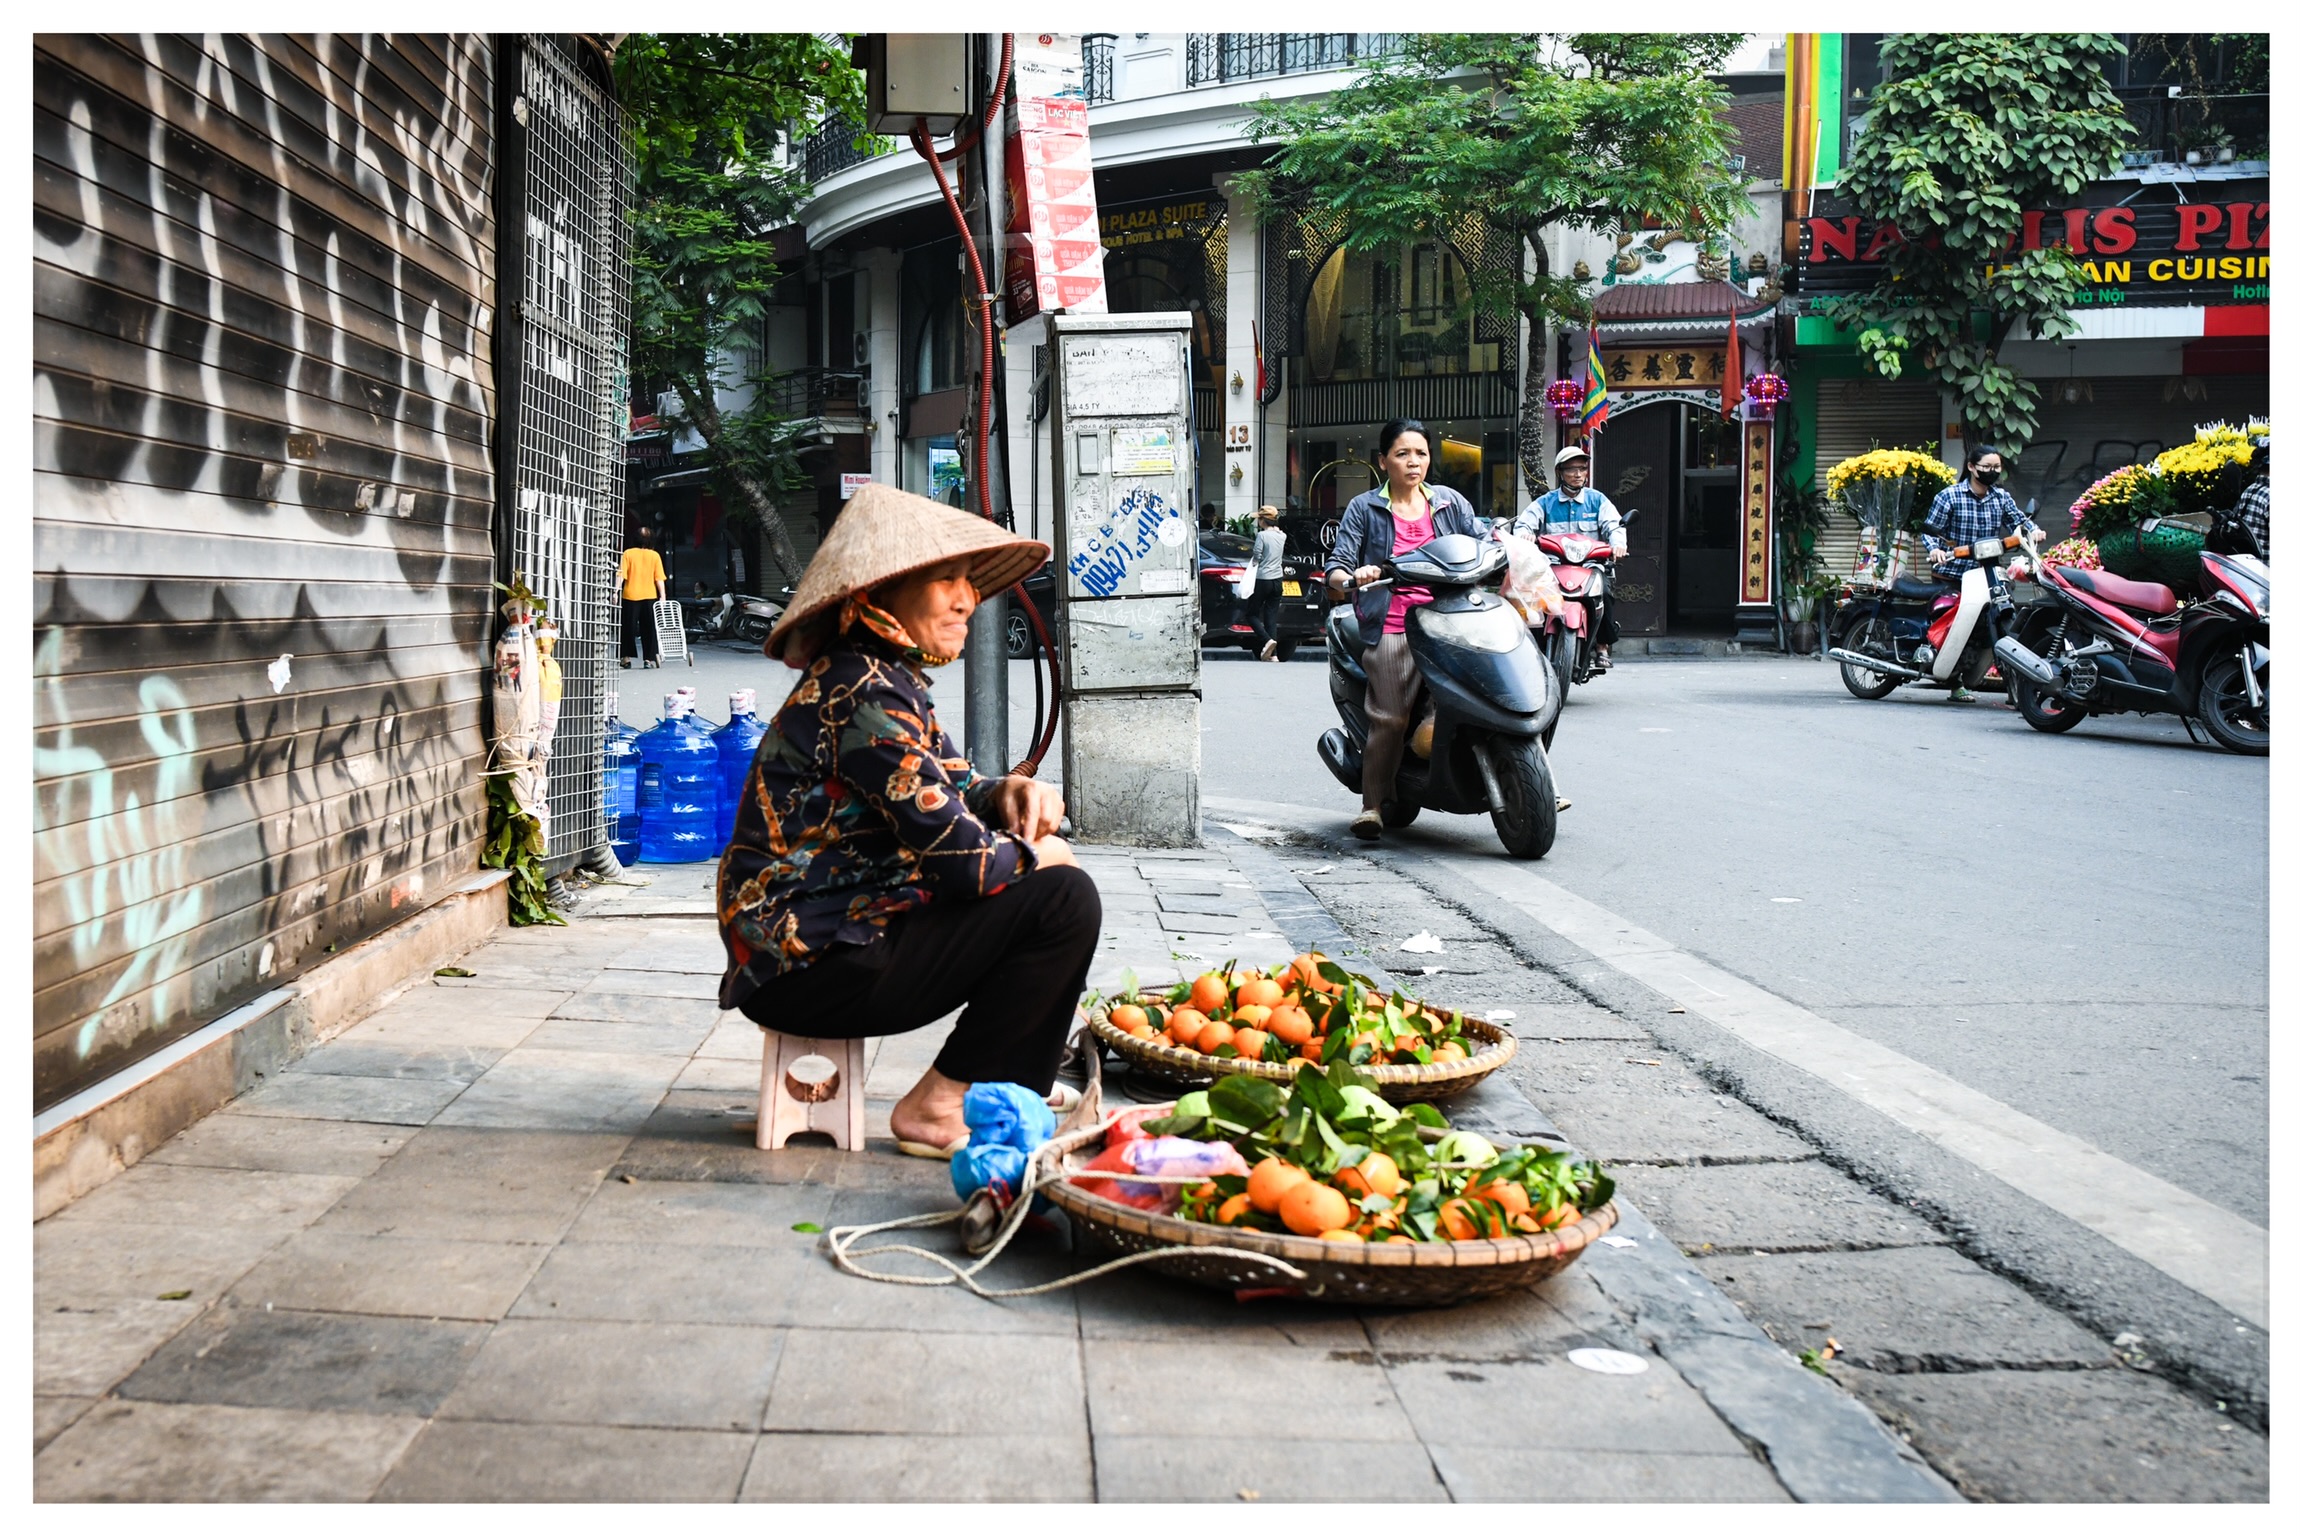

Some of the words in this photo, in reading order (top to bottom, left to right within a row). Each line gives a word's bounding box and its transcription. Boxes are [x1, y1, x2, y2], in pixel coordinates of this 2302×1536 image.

[1111, 209, 1157, 231] PLAZA
[1163, 202, 1207, 224] SUITE
[1805, 206, 2138, 263] NALIS
[1229, 425, 1249, 444] 13
